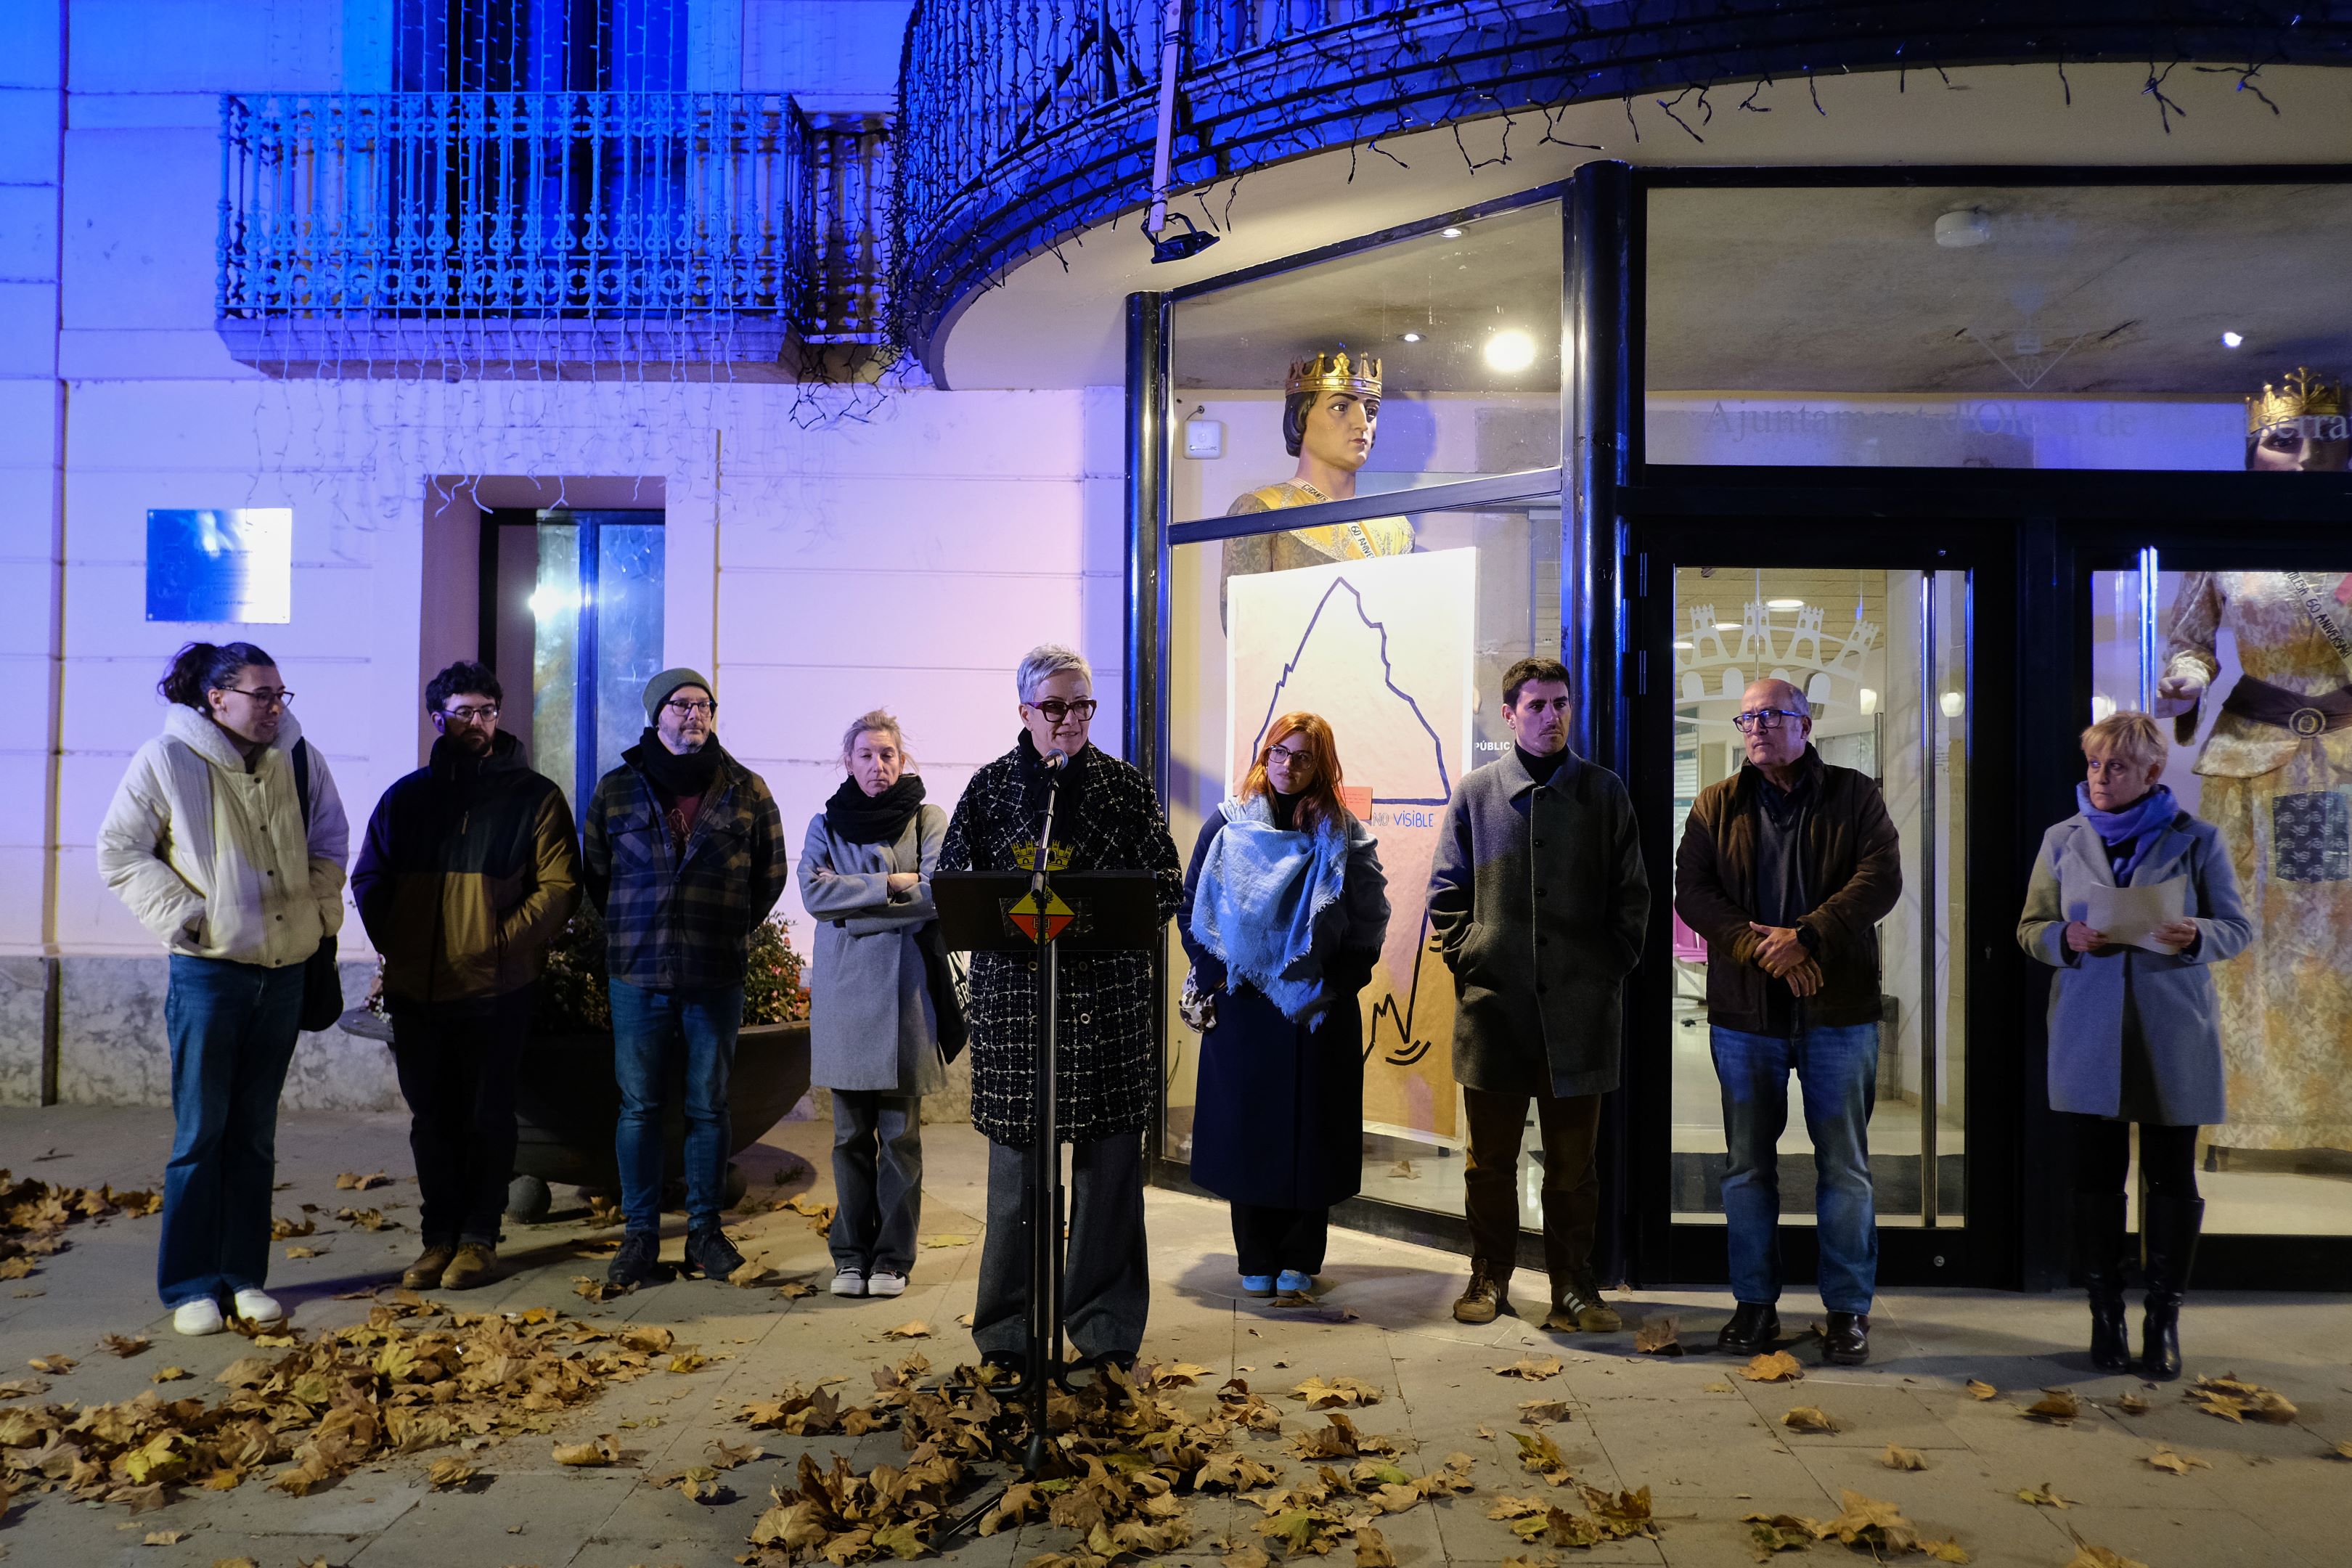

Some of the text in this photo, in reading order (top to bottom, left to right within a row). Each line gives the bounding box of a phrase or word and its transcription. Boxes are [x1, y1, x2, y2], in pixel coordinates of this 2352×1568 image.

[1941, 401, 2078, 436] d'Olea
[2095, 404, 2138, 438] de
[1350, 526, 1375, 559] 60 ANIVE
[2284, 572, 2310, 596] OLESA
[2306, 598, 2322, 613] 60
[1474, 740, 1511, 751] PÚBLIC
[1373, 812, 1389, 827] NO
